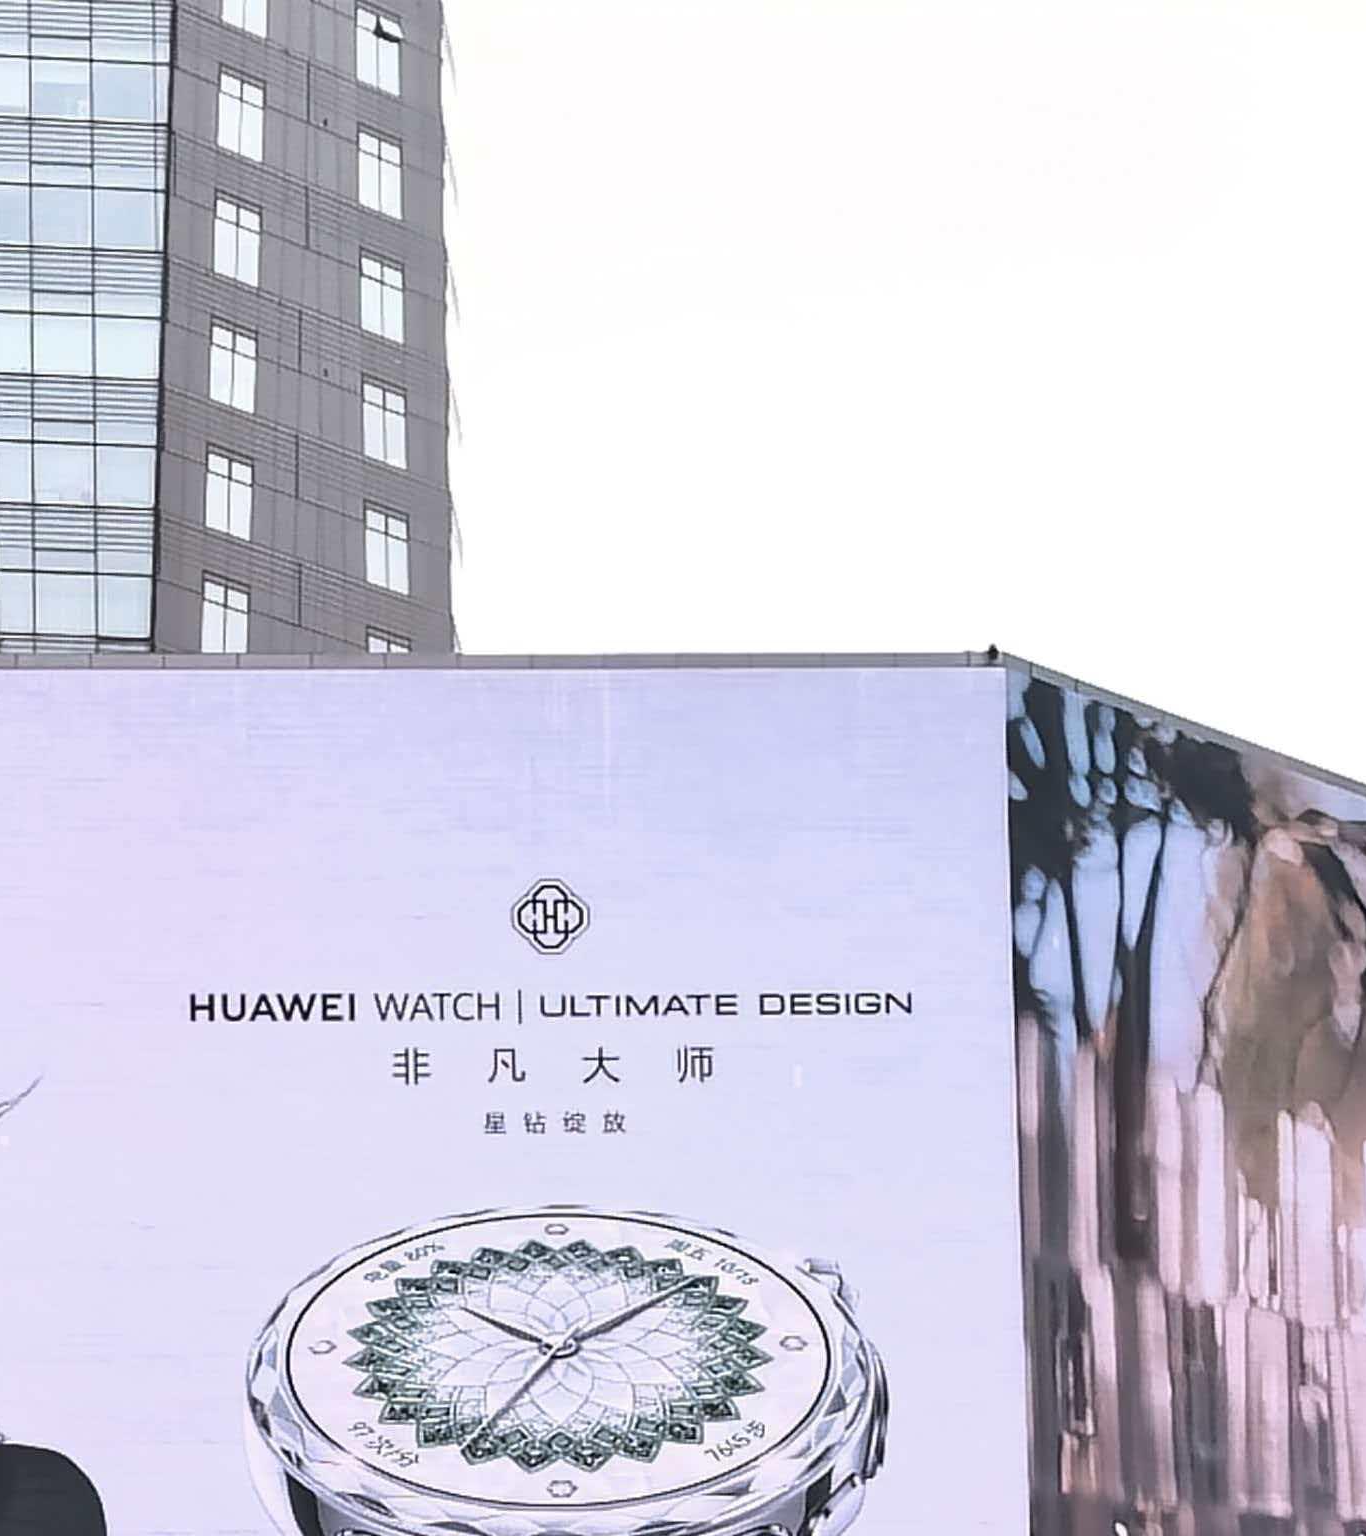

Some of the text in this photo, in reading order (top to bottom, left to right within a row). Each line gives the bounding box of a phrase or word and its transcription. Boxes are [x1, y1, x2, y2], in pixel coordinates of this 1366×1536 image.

[188, 991, 913, 1023] HUAWEI WATCH ULTIMATE DESIGN
[391, 1044, 716, 1087] 非凡大师
[483, 1110, 627, 1135] 星钻绽放
